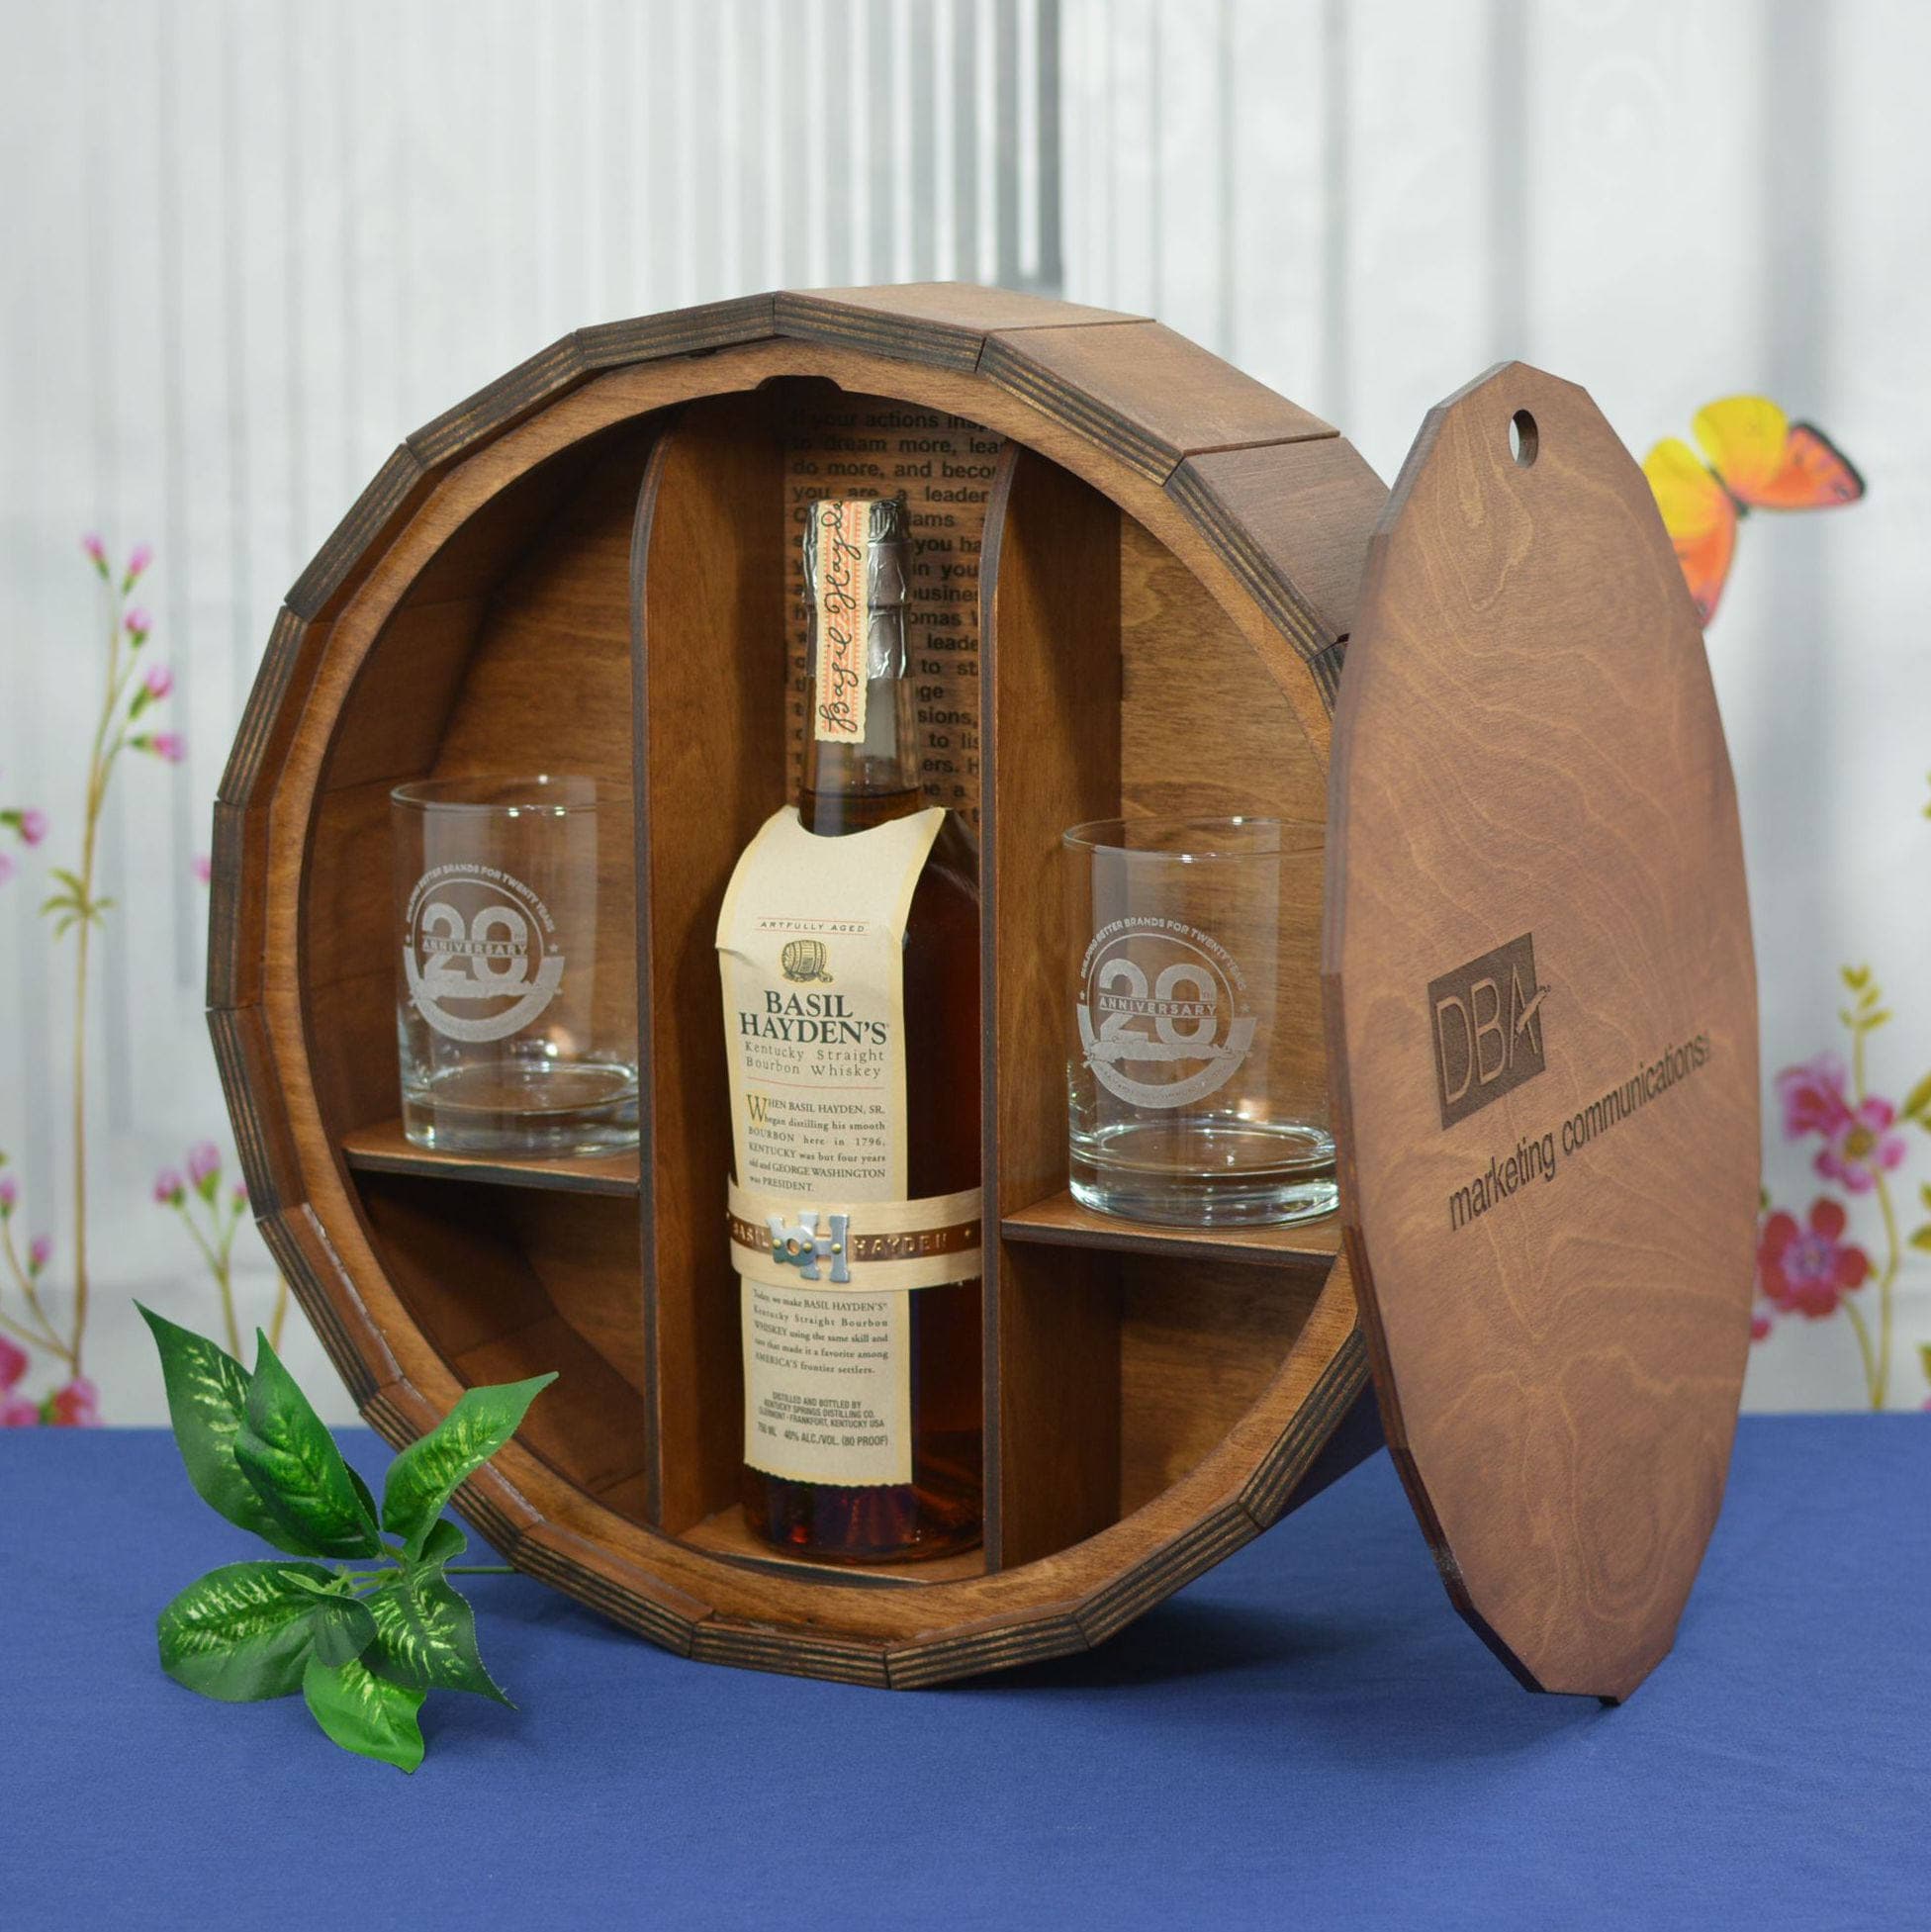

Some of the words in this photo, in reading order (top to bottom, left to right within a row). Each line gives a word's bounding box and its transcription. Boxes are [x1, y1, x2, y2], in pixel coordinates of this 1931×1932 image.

[866, 410, 939, 428] actions
[824, 434, 887, 452] dream
[898, 438, 957, 456] more,
[792, 459, 819, 477] do
[827, 461, 884, 479] more,
[894, 460, 933, 478] and
[792, 486, 831, 503] you
[848, 487, 879, 498] are
[895, 487, 907, 501] a
[925, 485, 989, 503] leader
[908, 512, 955, 527] ams
[914, 538, 953, 556] you
[960, 536, 981, 553] ha
[913, 586, 979, 601] usine
[909, 611, 962, 626] omas
[927, 633, 979, 651] leade
[921, 660, 941, 676] to
[917, 708, 979, 727] sions,
[930, 733, 950, 749] to
[442, 863, 481, 874] BRANDS
[481, 865, 503, 880] FOR
[502, 872, 539, 905] TWENTY
[761, 921, 824, 932] ARTFULLY
[830, 923, 866, 933] AGED
[422, 901, 529, 983] 20
[422, 939, 528, 957] ANNIVERSARY
[1124, 916, 1165, 929] BRANDS
[1166, 919, 1190, 935] FOR
[1190, 927, 1231, 963] TWENTY
[764, 989, 854, 1019] BASIL
[1099, 958, 1218, 1045] 20
[1099, 996, 1218, 1017] ANNIVERSARY
[739, 1011, 887, 1046] HAYDEN'S
[1436, 964, 1546, 1106] DBA
[744, 1041, 804, 1062] Kentucky
[816, 1049, 884, 1064] Straight
[746, 1056, 800, 1075] Bourbon
[810, 1063, 881, 1079] Whiskey
[746, 1093, 786, 1124] WHEN
[788, 1100, 815, 1114] BASIL
[818, 1103, 867, 1116] HAYDEN,
[869, 1104, 886, 1115] SR.
[765, 1114, 786, 1128] began
[788, 1117, 829, 1133] distilling
[832, 1120, 847, 1131] his
[849, 1121, 886, 1131] smooth
[748, 1125, 795, 1143] BOURBON
[803, 1136, 825, 1146] here
[834, 1137, 845, 1147] in
[855, 1137, 886, 1148] 1796.
[748, 1141, 797, 1159] KENTUCKY
[798, 1152, 815, 1161] was
[818, 1151, 835, 1162] but
[837, 1152, 859, 1163] four
[861, 1154, 886, 1165] years
[772, 1161, 810, 1177] GEORGE
[810, 1166, 886, 1179] WASHINGTON
[762, 1176, 815, 1193] PRESIDENT.
[1448, 1132, 1556, 1233] marketing
[853, 1232, 948, 1254] HAYDEN
[782, 1296, 803, 1309] make
[803, 1299, 830, 1310] BASIL
[754, 1304, 788, 1324] Kentucky
[794, 1313, 835, 1329] Straight
[841, 1318, 888, 1328] Bourbon
[754, 1320, 788, 1336] WHISKEY
[789, 1329, 811, 1342] using
[812, 1331, 825, 1341] the
[827, 1334, 850, 1343] same
[851, 1333, 870, 1343] skill
[872, 1334, 888, 1343] and
[782, 1342, 802, 1354] made
[820, 1347, 856, 1359] favorite
[857, 1349, 889, 1361] among
[755, 1351, 798, 1369] AMERICA'S
[799, 1361, 835, 1373] frontier
[837, 1365, 875, 1375] settlers.
[772, 1390, 802, 1405] DISTILLED
[803, 1396, 817, 1407] AND
[819, 1398, 850, 1410] BOTTLED
[851, 1400, 863, 1410] BY
[822, 1408, 862, 1419] DISTILLING
[830, 1418, 868, 1429] KENTUCKY
[869, 1419, 885, 1428] USA
[841, 1434, 855, 1446] (80
[856, 1434, 889, 1447] PROOF)
